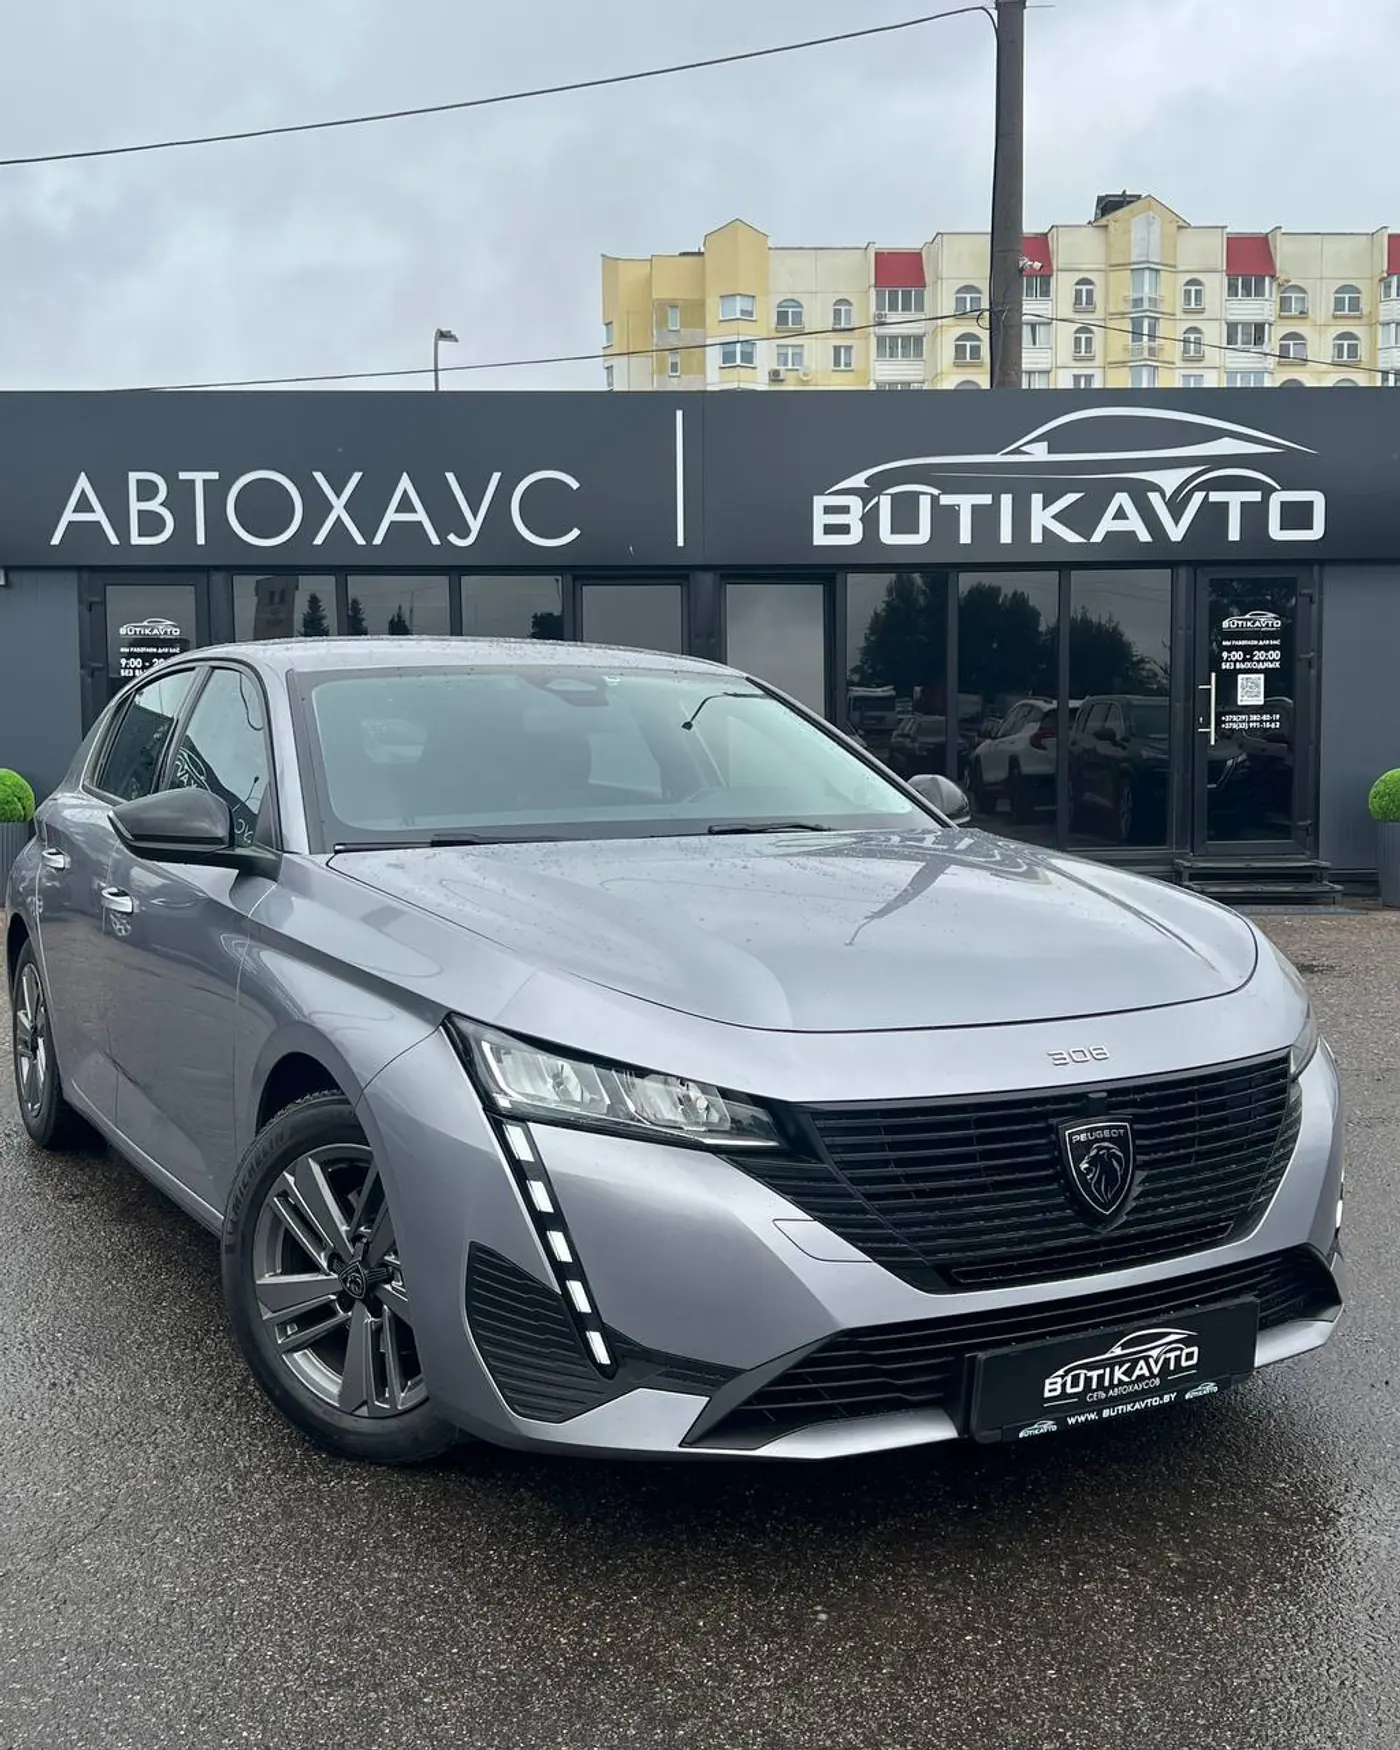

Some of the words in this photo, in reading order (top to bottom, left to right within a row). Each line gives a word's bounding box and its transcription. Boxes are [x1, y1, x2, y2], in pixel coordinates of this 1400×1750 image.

[50, 470, 582, 548] АВТОХАУС
[812, 488, 1326, 546] BUTIKAVTO
[119, 627, 181, 636] BUTIKAVTO
[1222, 619, 1281, 628] BUTIKAVTO
[120, 658, 142, 668] 9:00
[1221, 651, 1243, 661] 9:00
[1252, 650, 1281, 661] 20:00
[1221, 661, 1235, 670] БЕЗ
[1236, 661, 1281, 669] ВЫХОДНЫХ
[1047, 1044, 1110, 1066] 308
[1072, 1129, 1125, 1143] PEUGEOT
[1043, 1346, 1199, 1399] BUTIKAVTO
[1086, 1390, 1106, 1402] СЕТЬ
[1107, 1377, 1160, 1397] АВТОХАУСОВ
[1067, 1411, 1099, 1425] WWW.
[1102, 1392, 1177, 1418] BUTIKAVTO.BY
